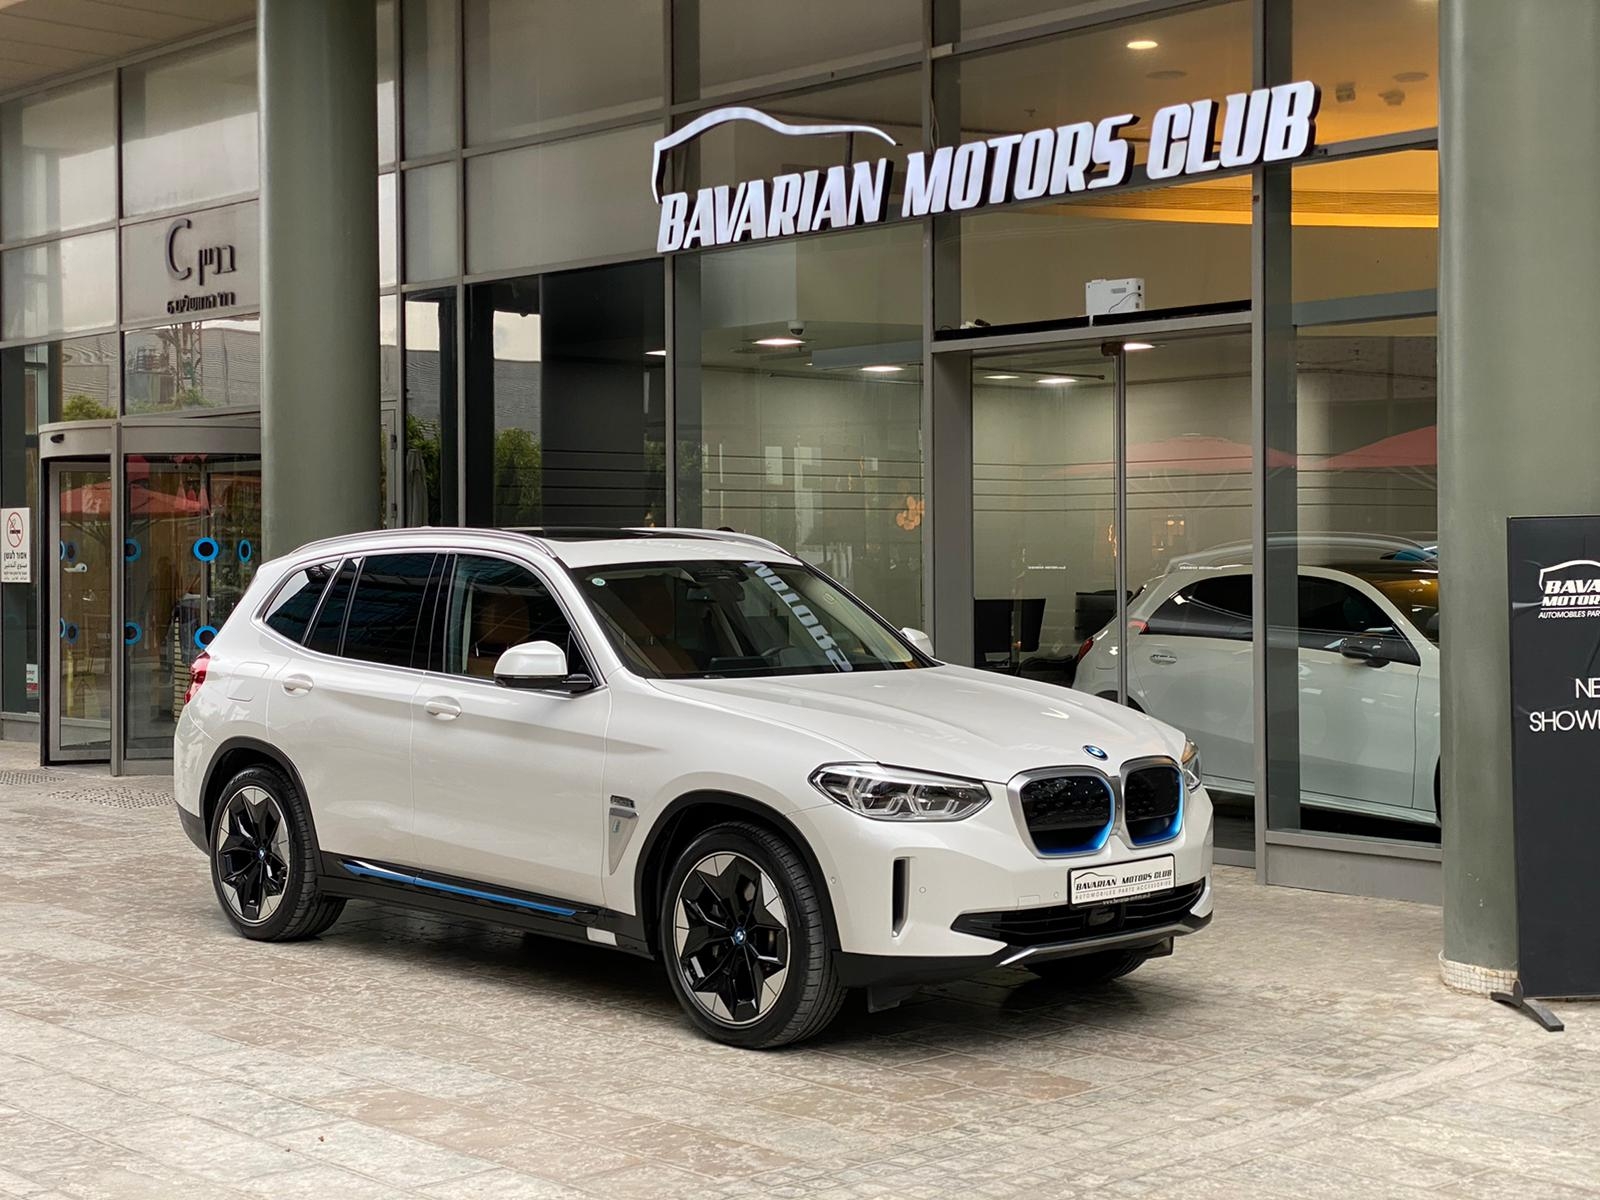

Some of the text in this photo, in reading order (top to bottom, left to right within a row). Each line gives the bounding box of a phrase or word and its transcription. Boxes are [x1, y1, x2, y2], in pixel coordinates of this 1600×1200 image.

[656, 80, 1318, 253] BAVARIAN MOTORS CLUB
[165, 217, 237, 286] בניין C
[1544, 579, 1600, 595] BAVA
[1541, 595, 1600, 607] MOTOR
[1538, 610, 1586, 619] AUTOMOBILES
[1575, 677, 1600, 699] NE
[1529, 709, 1600, 732] SHOW
[1076, 869, 1173, 891] BAVARIAN MOTORS CLUB
